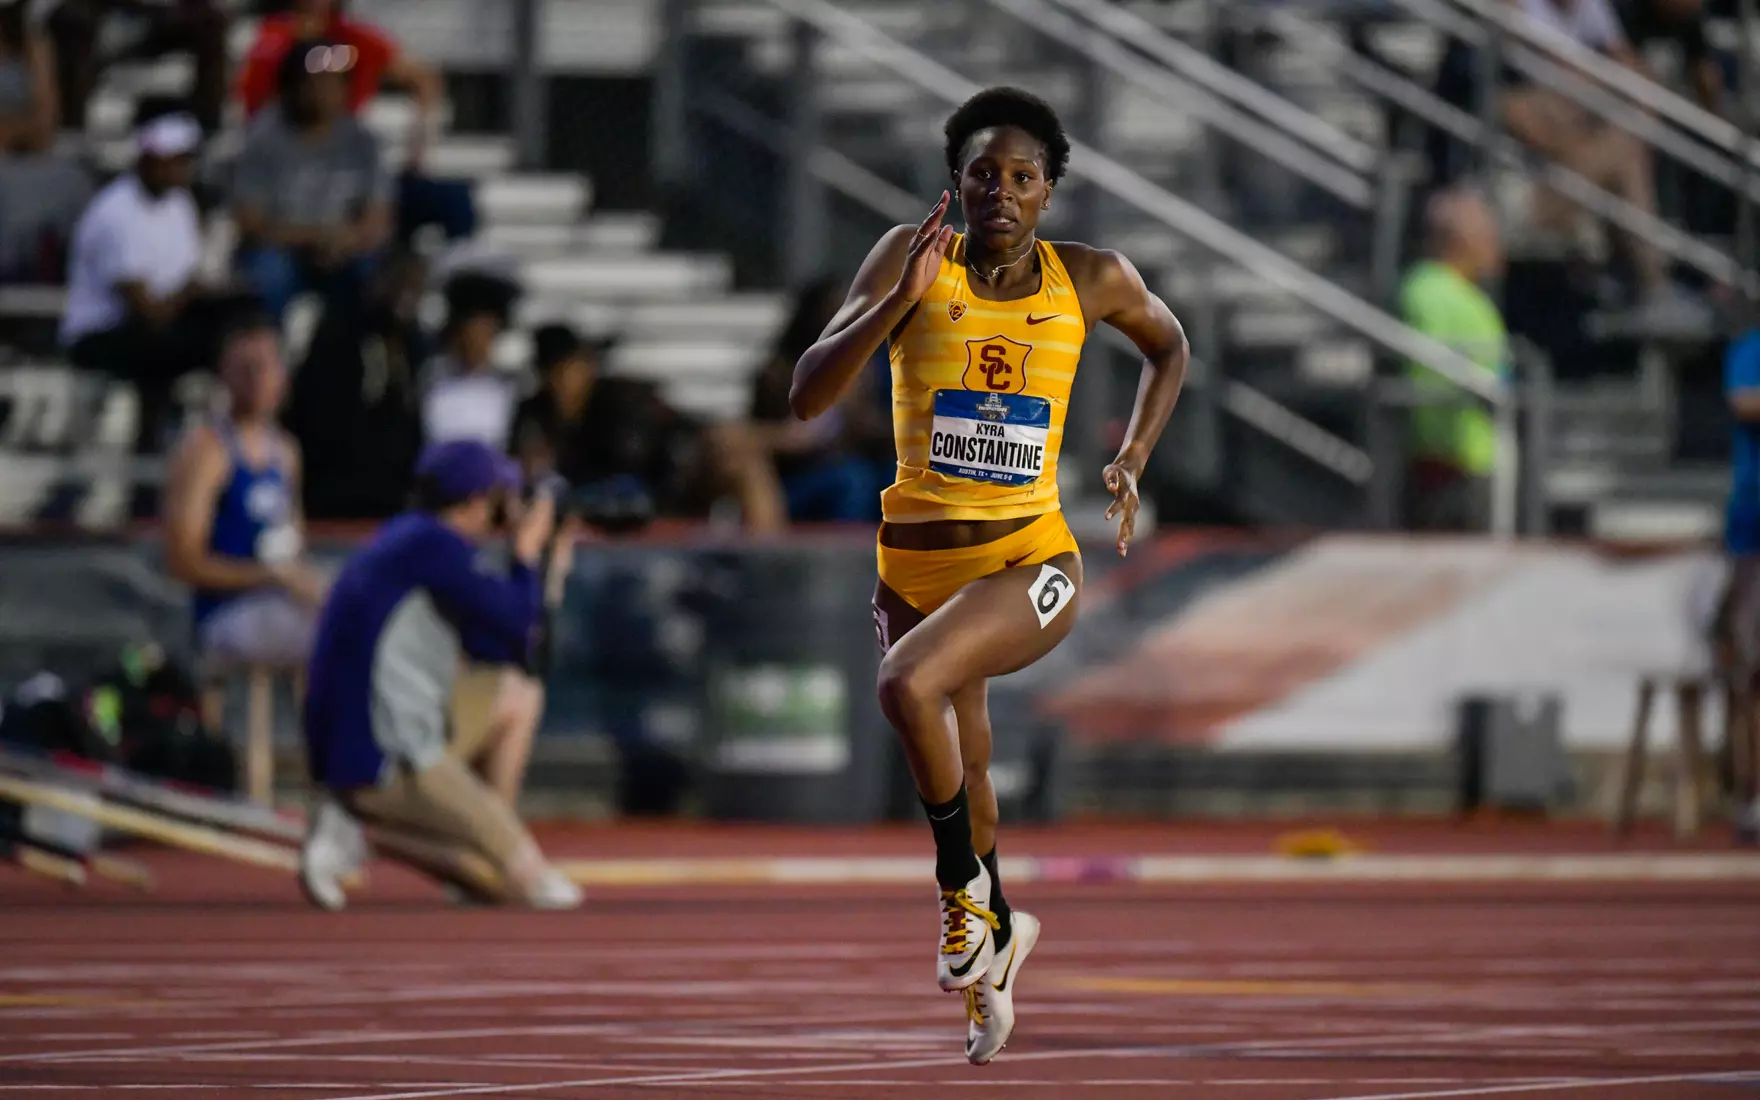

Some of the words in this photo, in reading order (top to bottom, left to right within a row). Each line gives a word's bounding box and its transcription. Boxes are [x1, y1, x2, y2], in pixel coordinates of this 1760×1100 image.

[976, 423, 1005, 438] KYRA
[932, 431, 1042, 471] CONSTANTINE
[1037, 573, 1069, 615] 6
